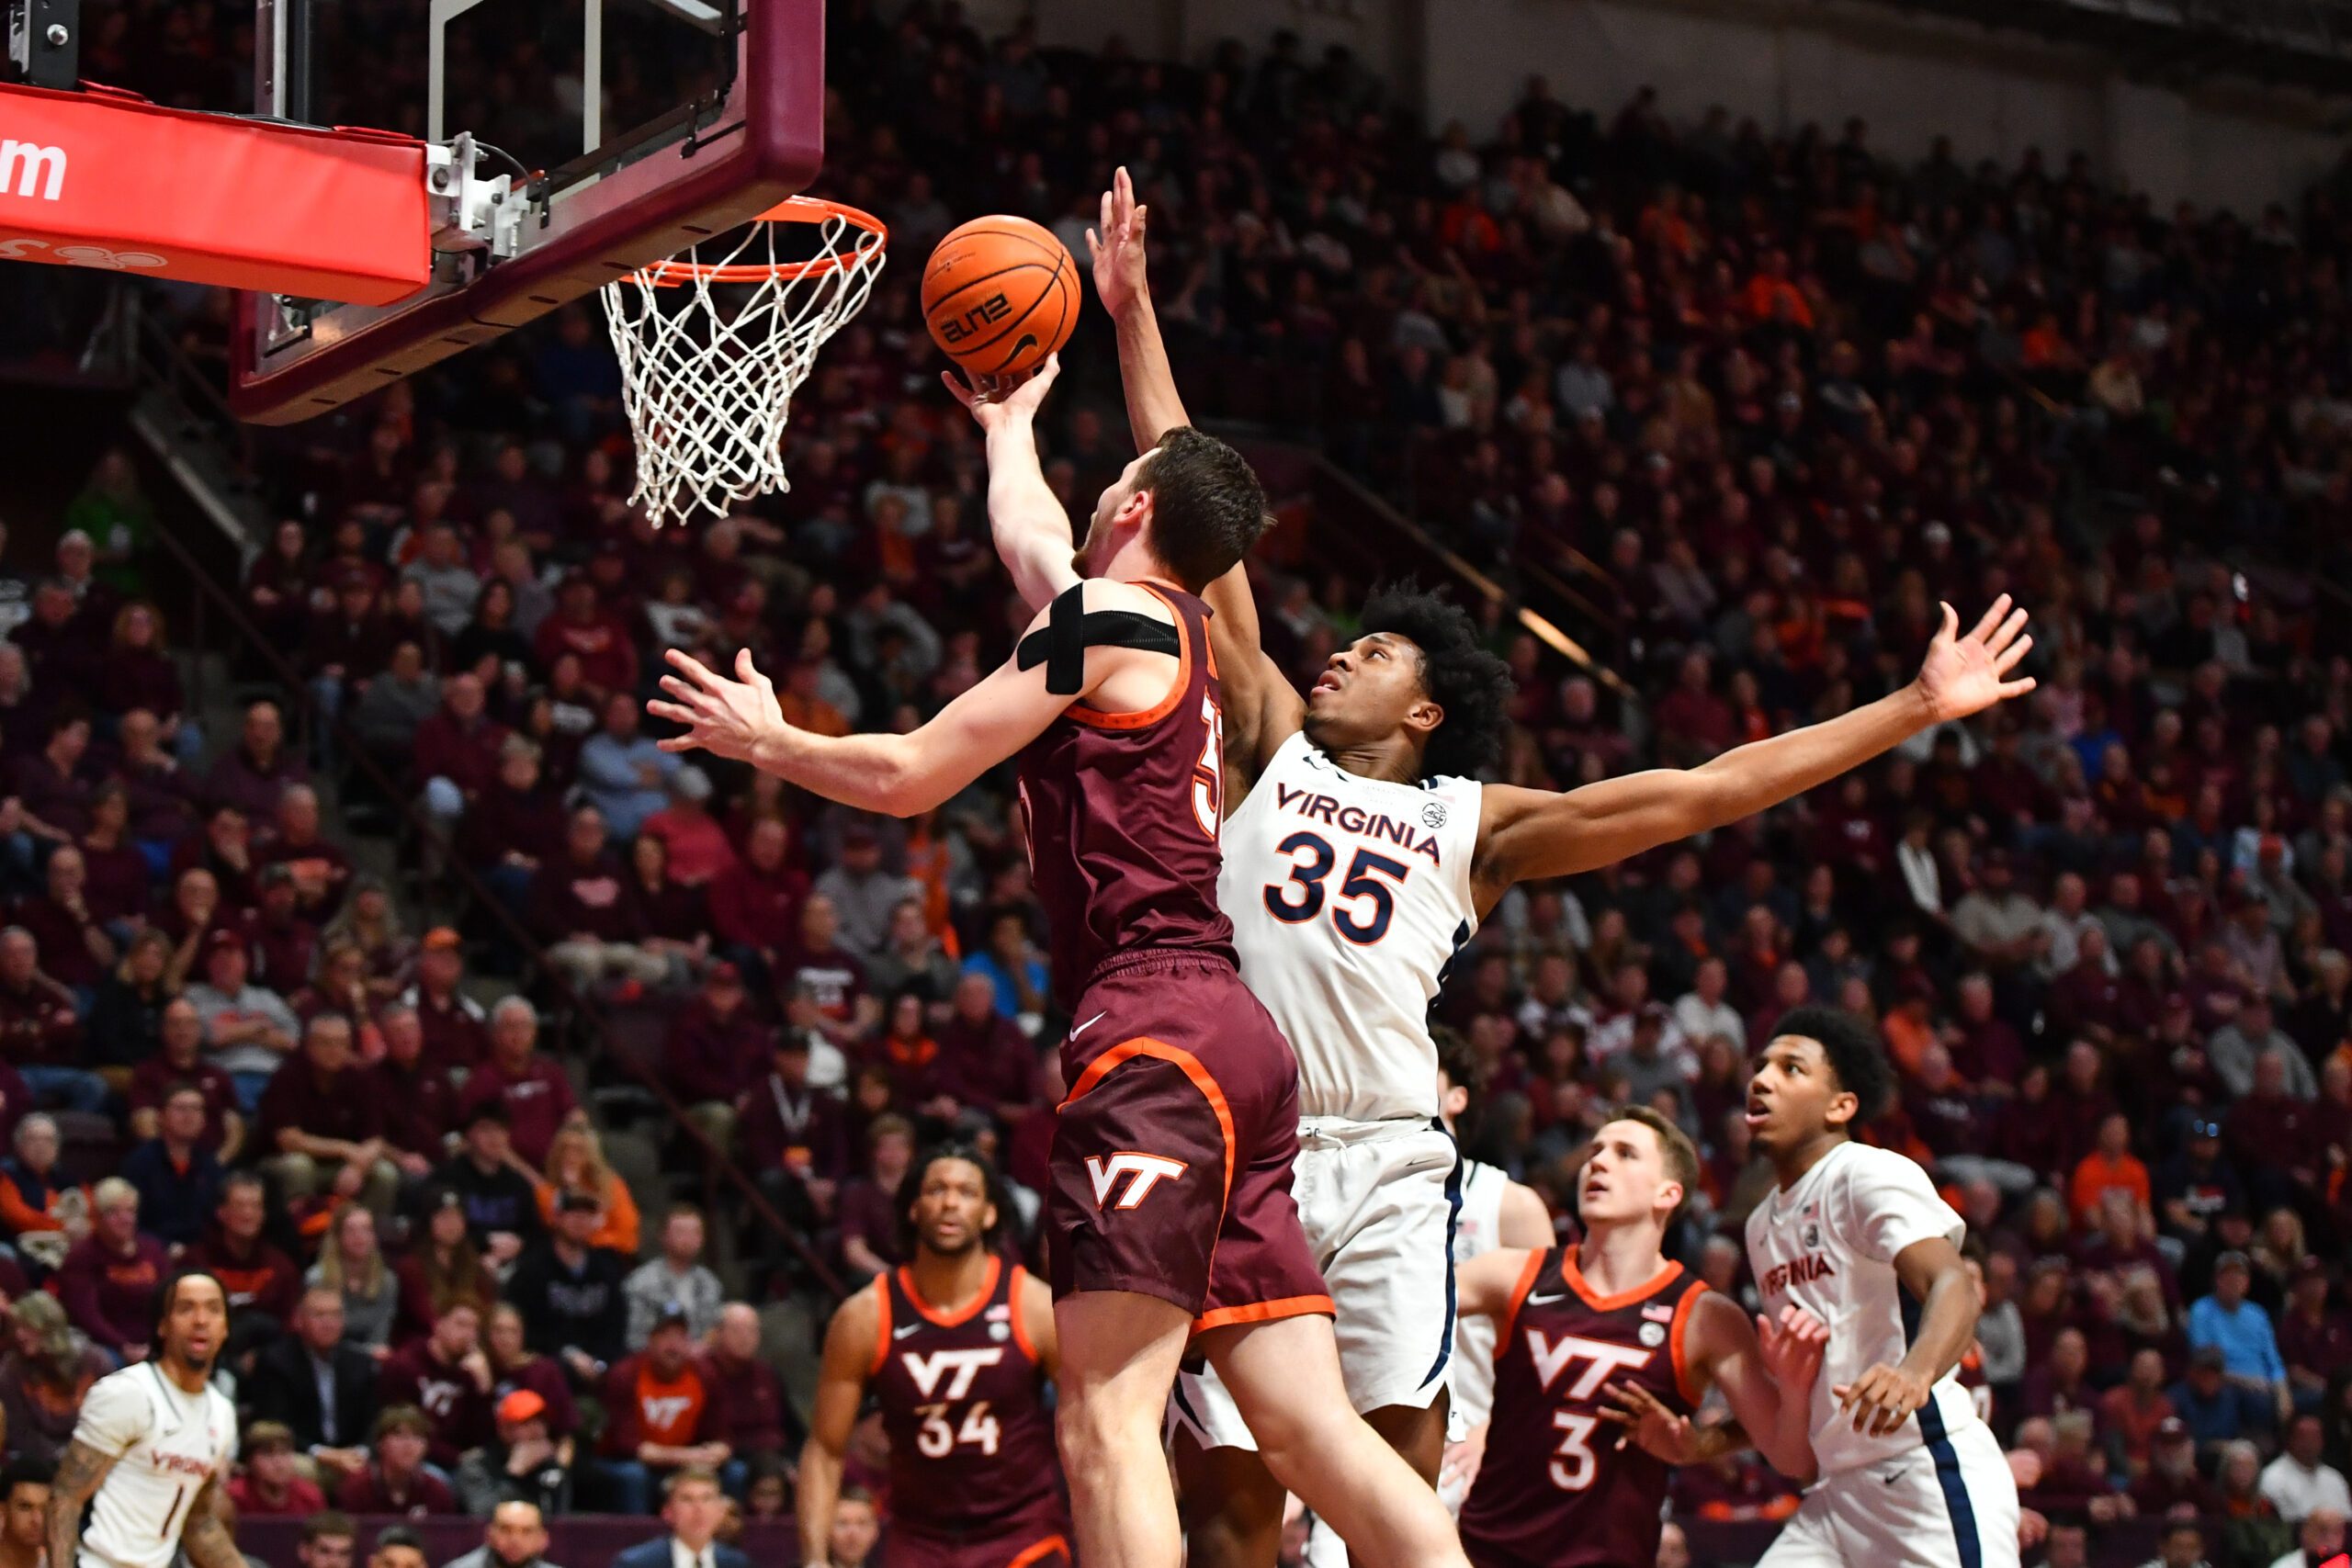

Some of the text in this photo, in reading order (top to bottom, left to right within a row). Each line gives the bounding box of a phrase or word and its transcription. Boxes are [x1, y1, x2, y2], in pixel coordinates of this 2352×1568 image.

[940, 292, 1012, 344] ELITE
[1277, 782, 1441, 868] VIRGINIA
[1262, 831, 1410, 946] 35
[1084, 1152, 1188, 1211] VT
[901, 1348, 1004, 1400] VT
[1523, 1328, 1654, 1400] VT
[914, 1401, 1000, 1459] 34
[1550, 1411, 1598, 1492] 3
[160, 1483, 185, 1539] 1
